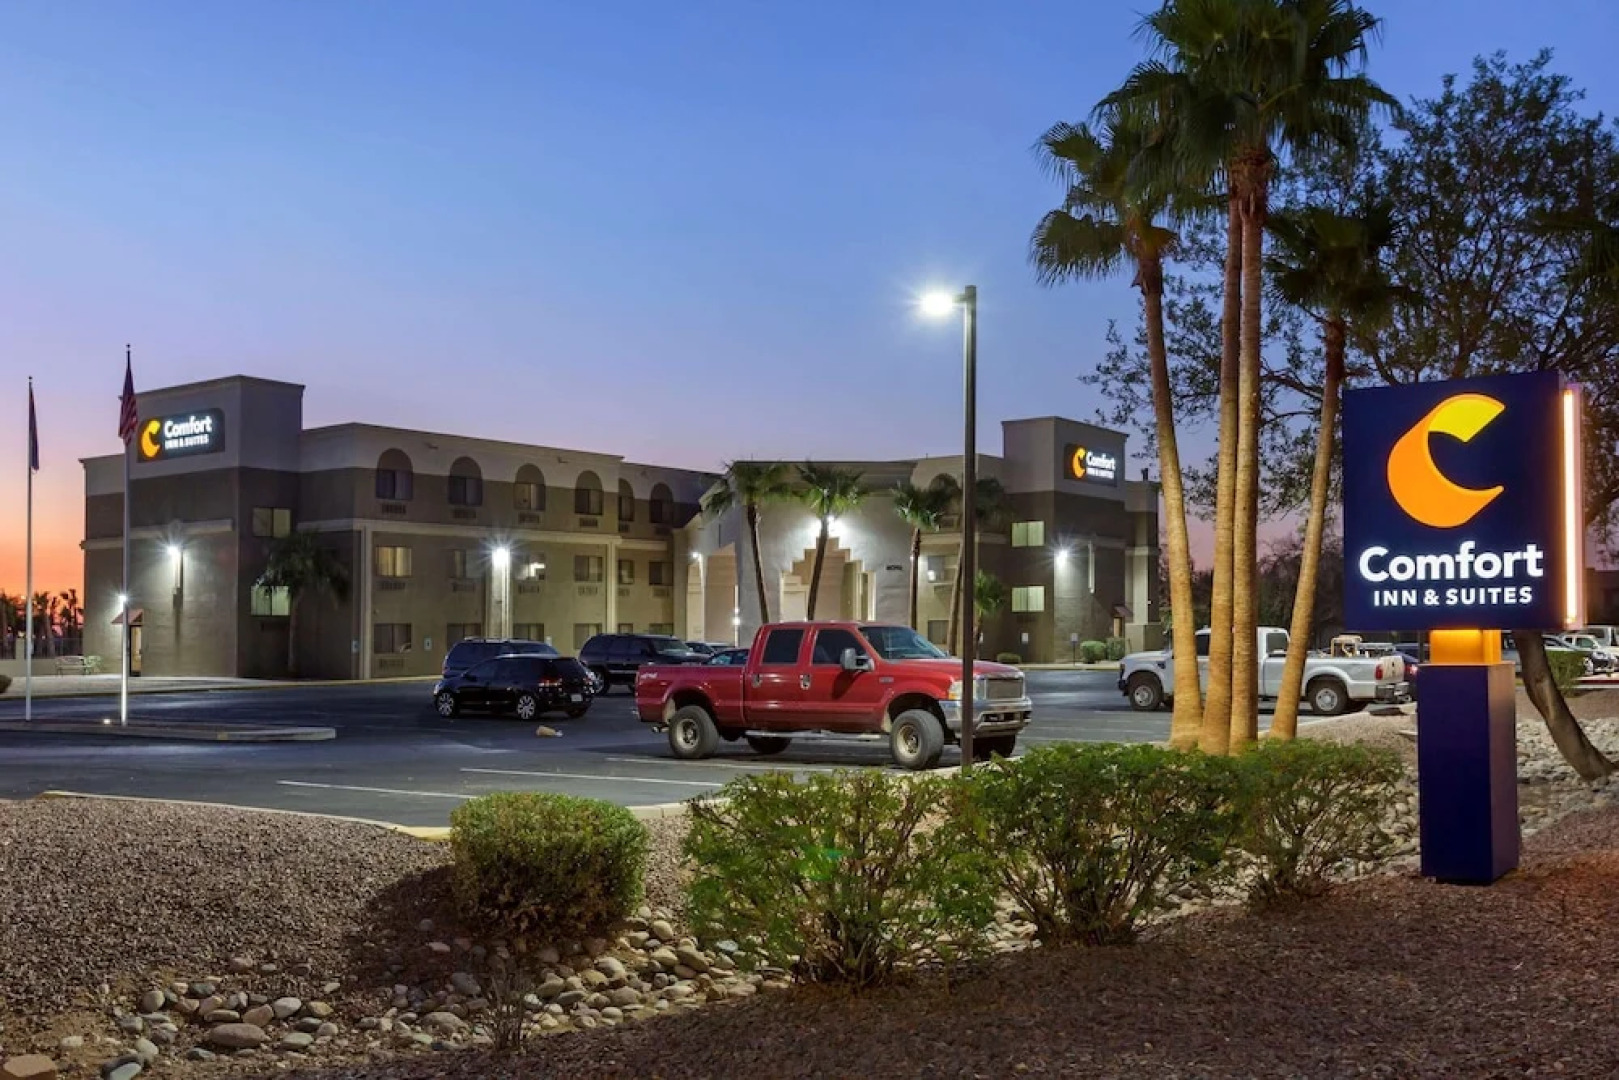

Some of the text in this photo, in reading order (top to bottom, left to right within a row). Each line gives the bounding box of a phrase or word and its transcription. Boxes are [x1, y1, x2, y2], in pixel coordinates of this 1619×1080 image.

[165, 415, 212, 438] Comfort
[1086, 451, 1115, 470] Comfort
[1359, 541, 1543, 582] Comfort
[1374, 586, 1533, 606] INN & SUITES
